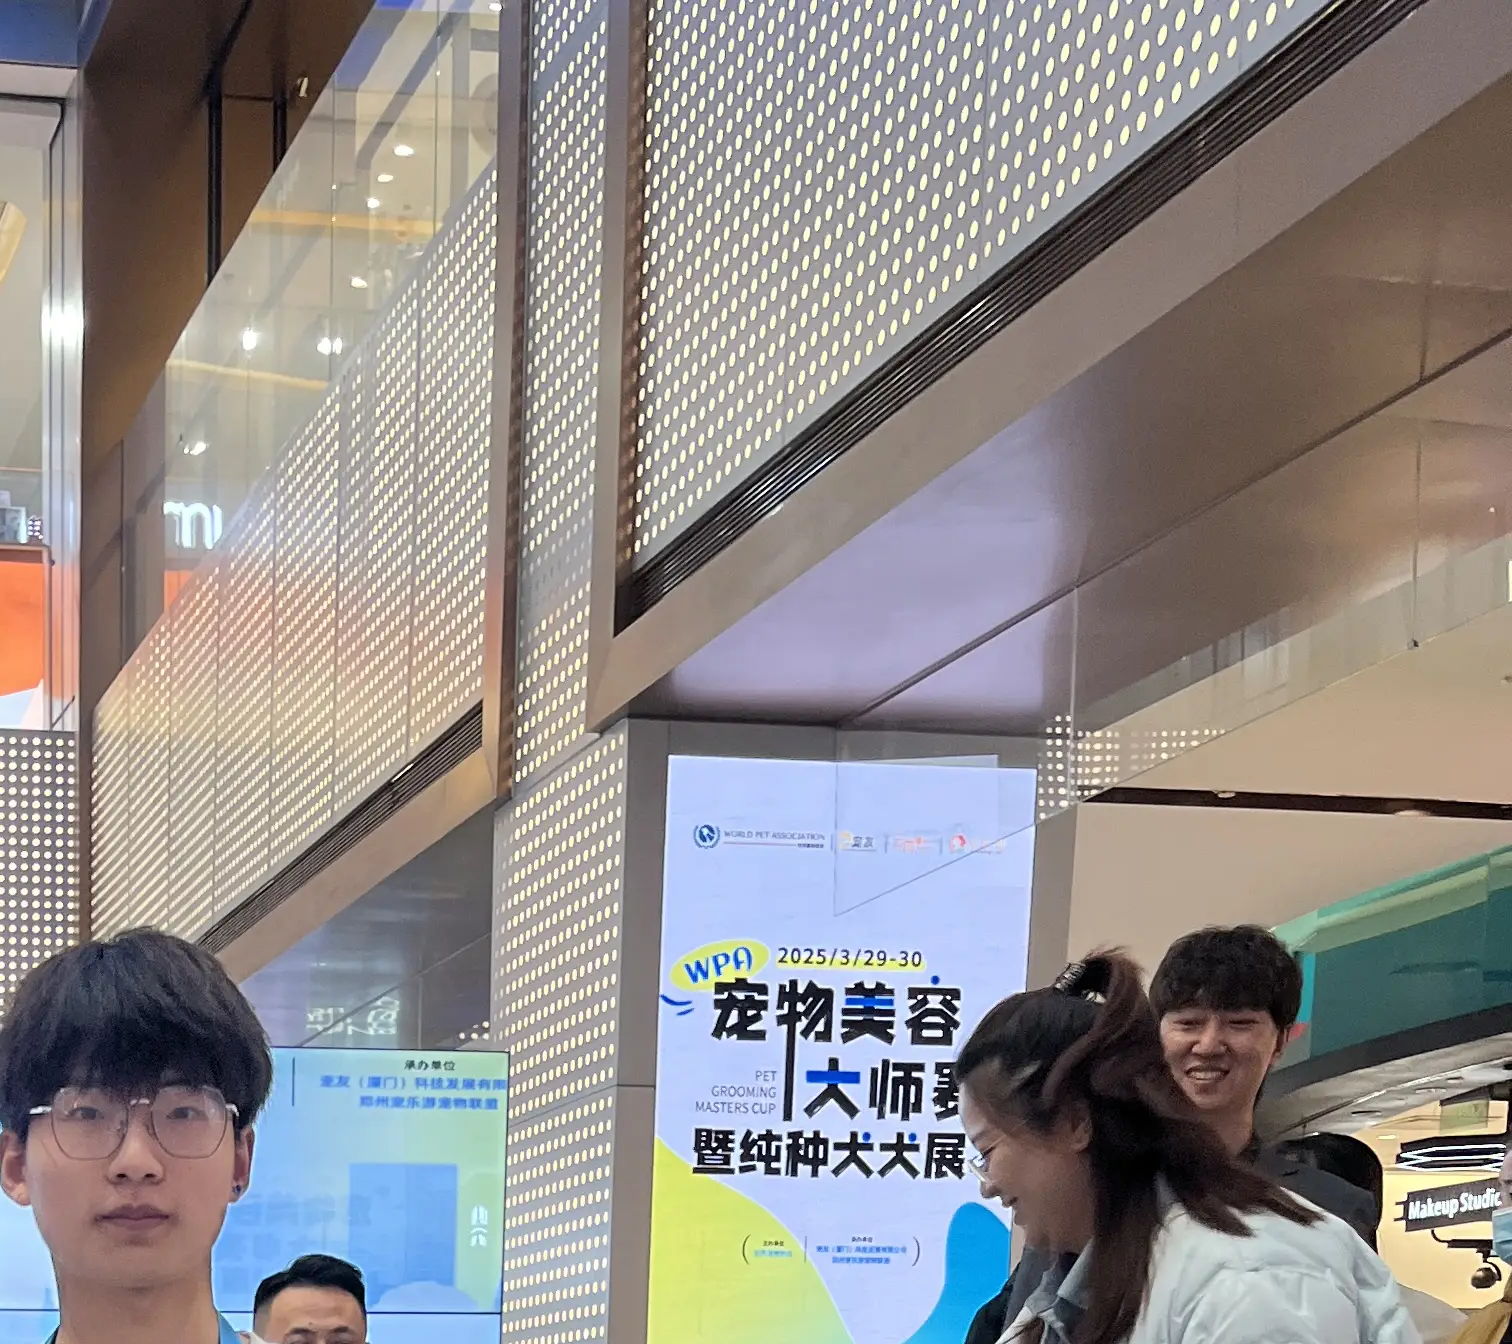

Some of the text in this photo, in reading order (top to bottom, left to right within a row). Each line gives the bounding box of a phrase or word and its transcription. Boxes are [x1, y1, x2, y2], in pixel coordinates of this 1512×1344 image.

[684, 946, 754, 985] WPA
[777, 946, 923, 968] 2025/3/29-30
[711, 977, 963, 1046] 宠物美容
[755, 1070, 778, 1083] PET
[711, 1086, 777, 1099] GROOMING
[694, 1100, 776, 1115] MASTERS CUP
[1407, 1196, 1460, 1221] Makeup
